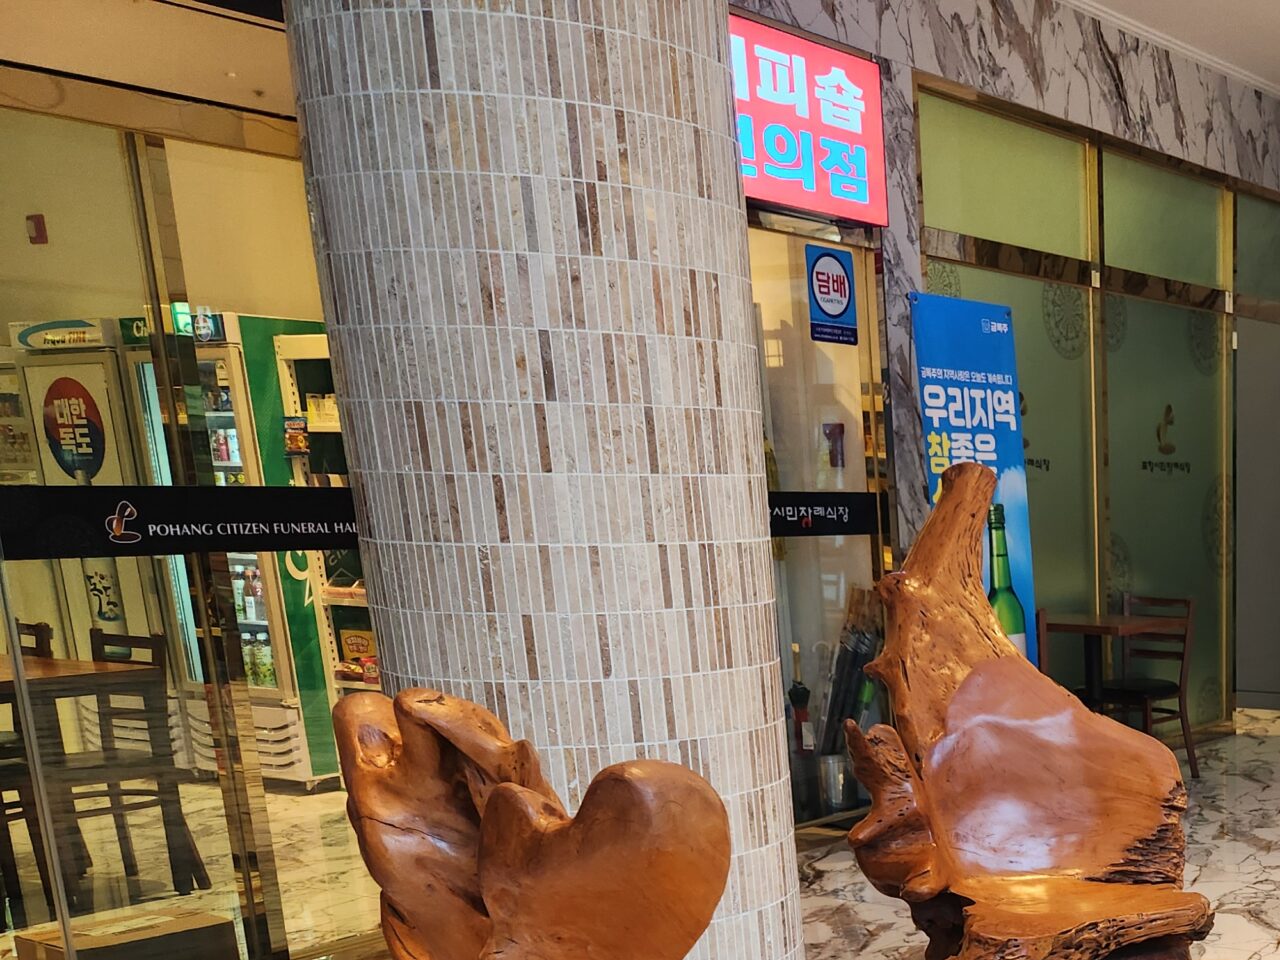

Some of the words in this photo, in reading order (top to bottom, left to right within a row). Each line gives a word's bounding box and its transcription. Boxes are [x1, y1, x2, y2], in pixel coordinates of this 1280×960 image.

[729, 34, 866, 134] 피숍
[815, 270, 848, 299] 담배
[53, 398, 88, 425] 대한
[923, 384, 1017, 432] 우리지역
[59, 428, 93, 456] 독도
[148, 523, 214, 537] POHANG
[216, 521, 270, 535] CITIZEN
[273, 521, 332, 535] FUNERAL
[334, 521, 358, 534] HAL
[769, 506, 849, 528] 시민장례식장
